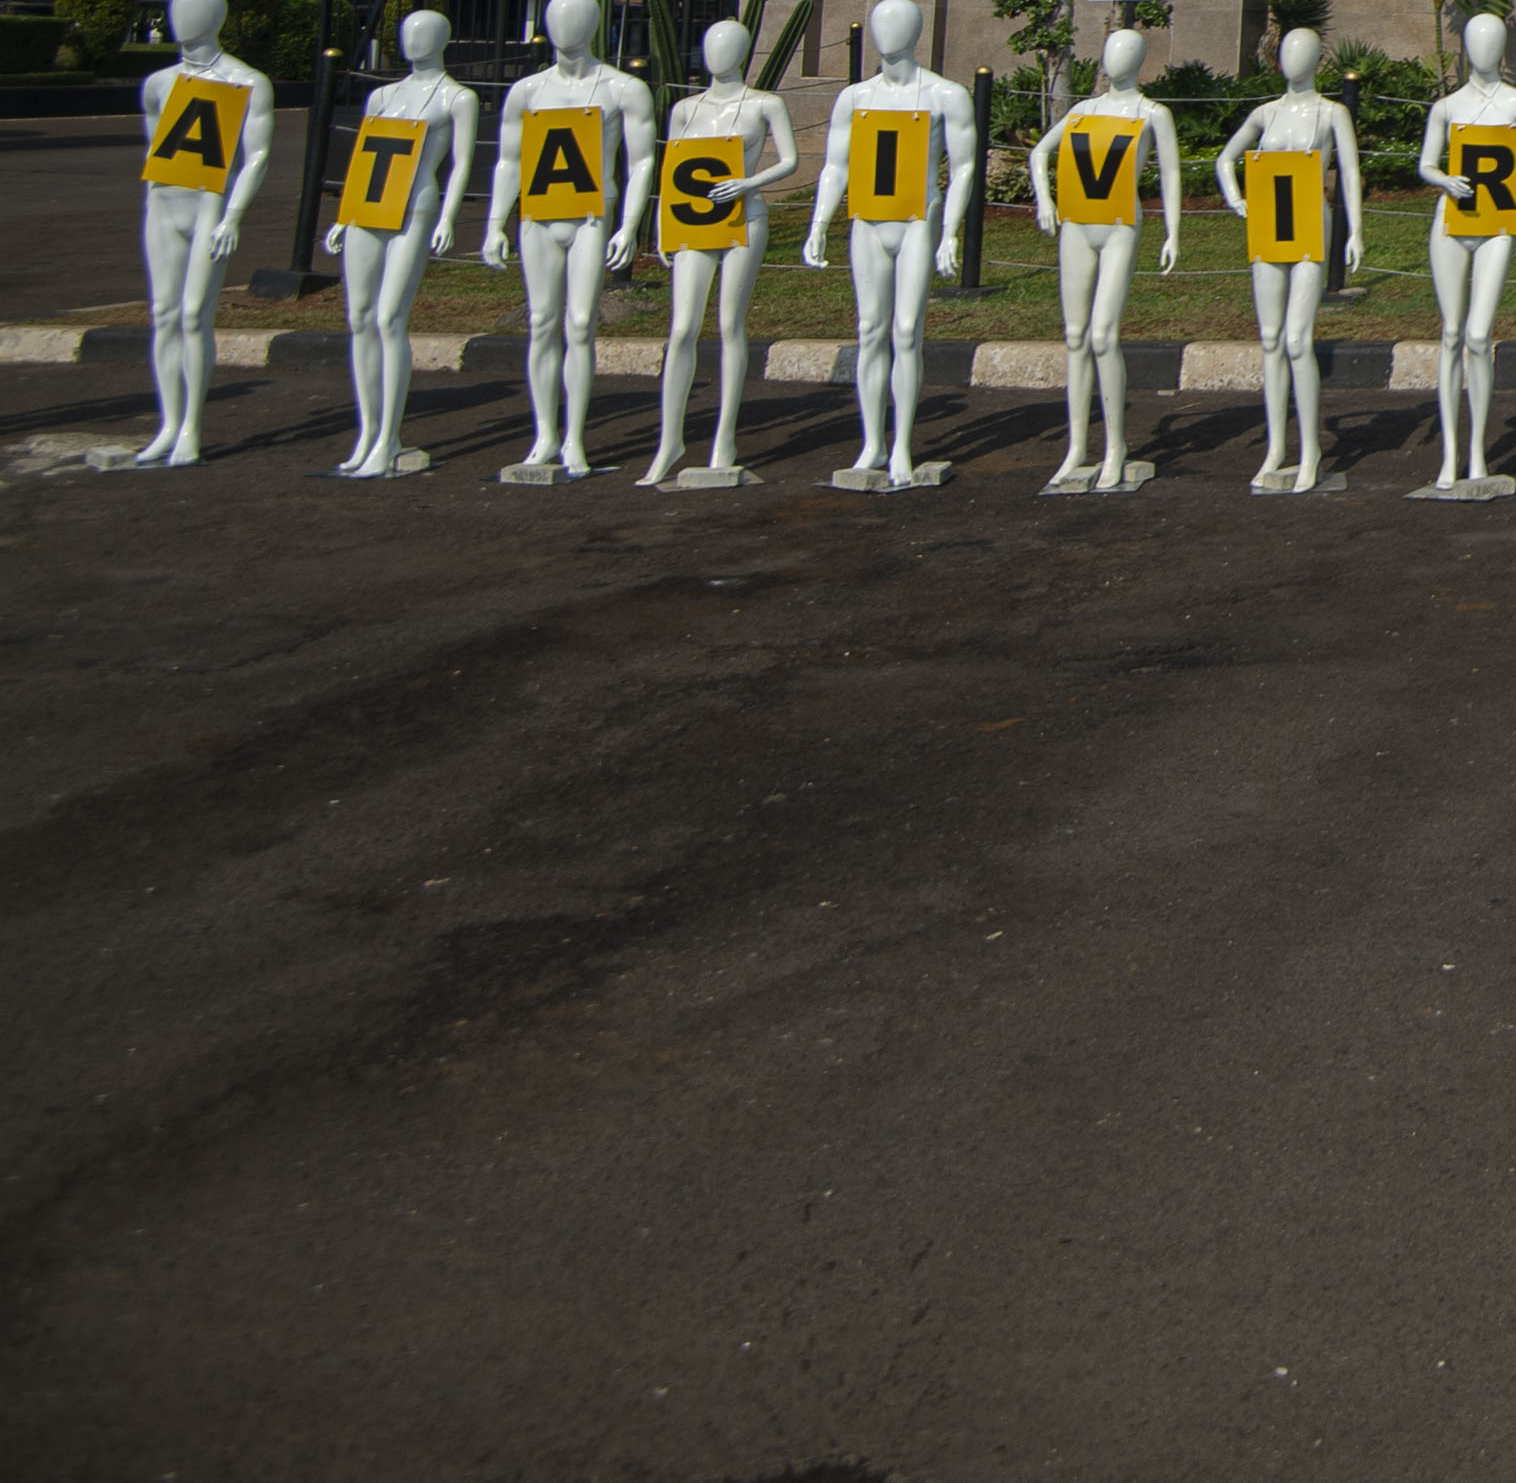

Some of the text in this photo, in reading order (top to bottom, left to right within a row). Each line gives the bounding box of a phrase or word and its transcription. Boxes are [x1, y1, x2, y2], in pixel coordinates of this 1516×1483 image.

[152, 98, 226, 170] A
[527, 127, 598, 196] A
[873, 130, 898, 197] I
[1070, 132, 1134, 200] V
[362, 135, 415, 205] T
[670, 157, 740, 226] S
[1273, 175, 1295, 242] I
